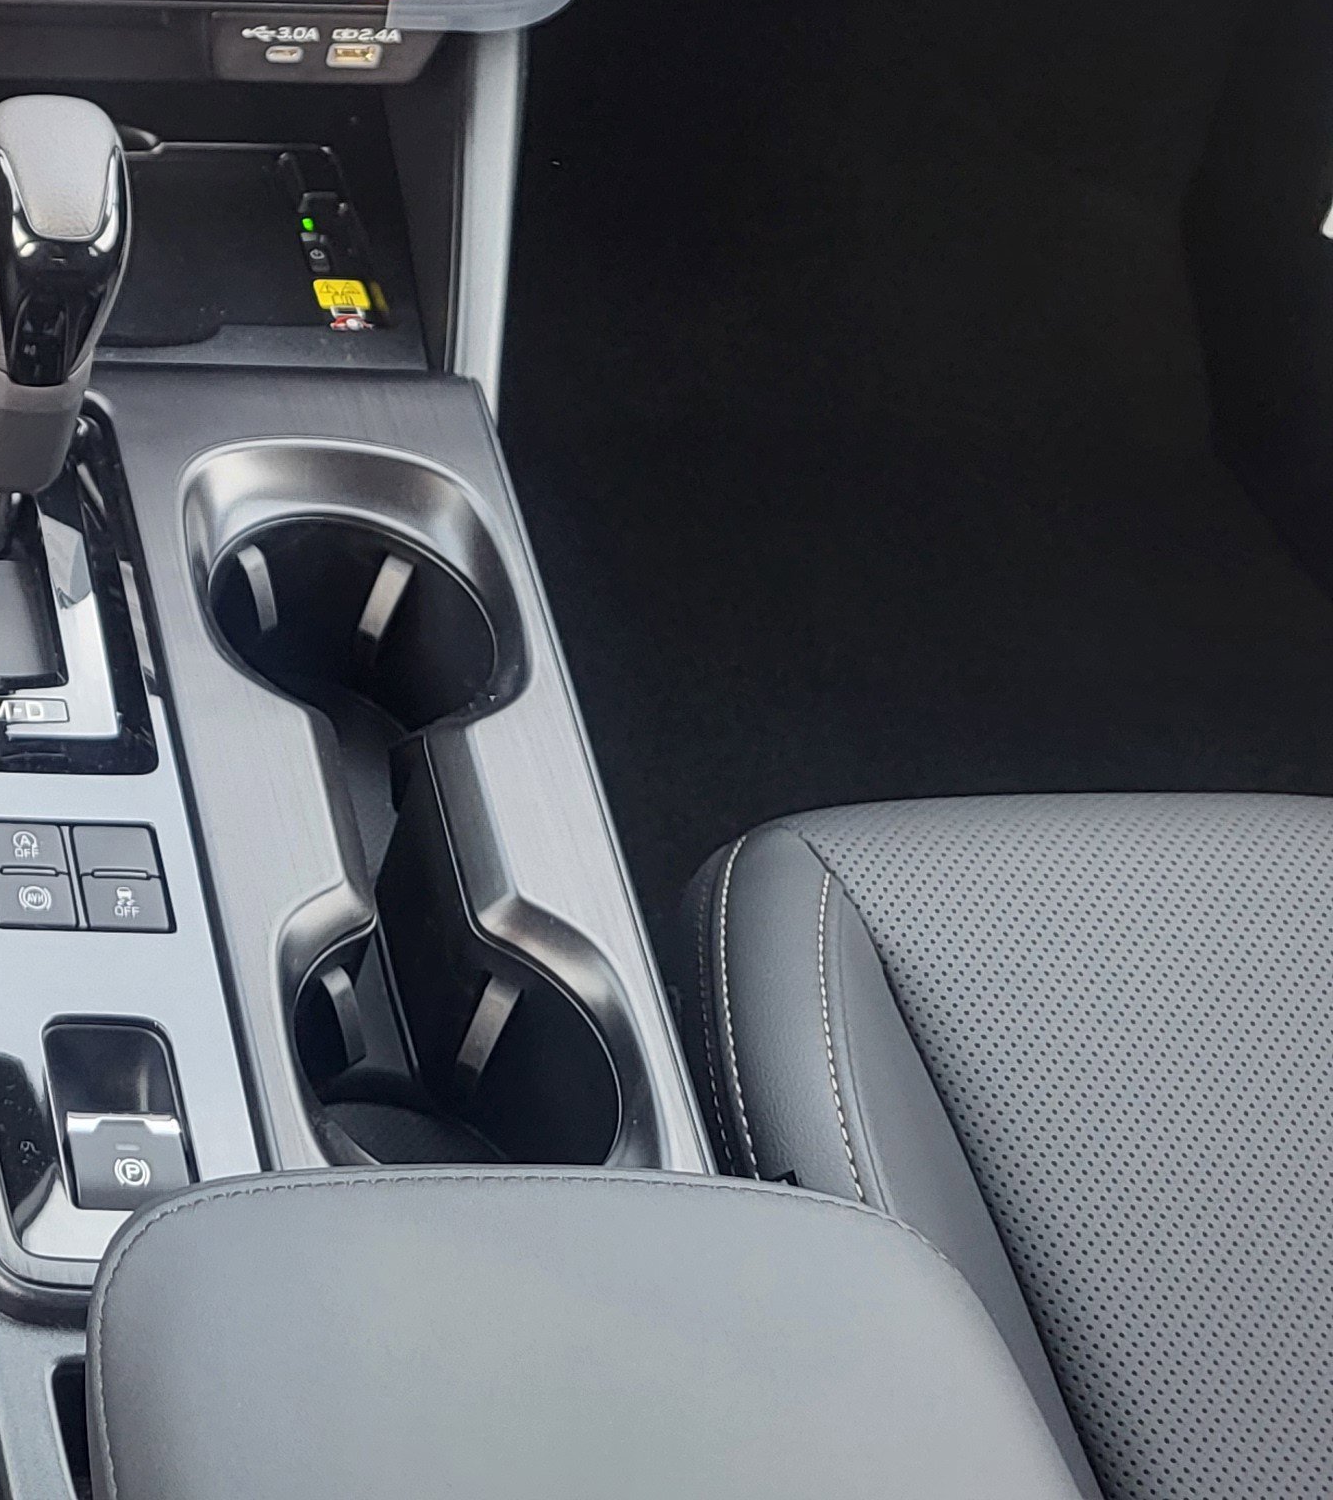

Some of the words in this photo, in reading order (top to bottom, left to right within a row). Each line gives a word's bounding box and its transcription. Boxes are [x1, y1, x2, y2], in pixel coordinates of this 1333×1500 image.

[277, 27, 320, 42] 3.0A
[358, 27, 402, 43] 2.4A
[14, 847, 39, 859] OFF
[114, 905, 140, 918] OFF
